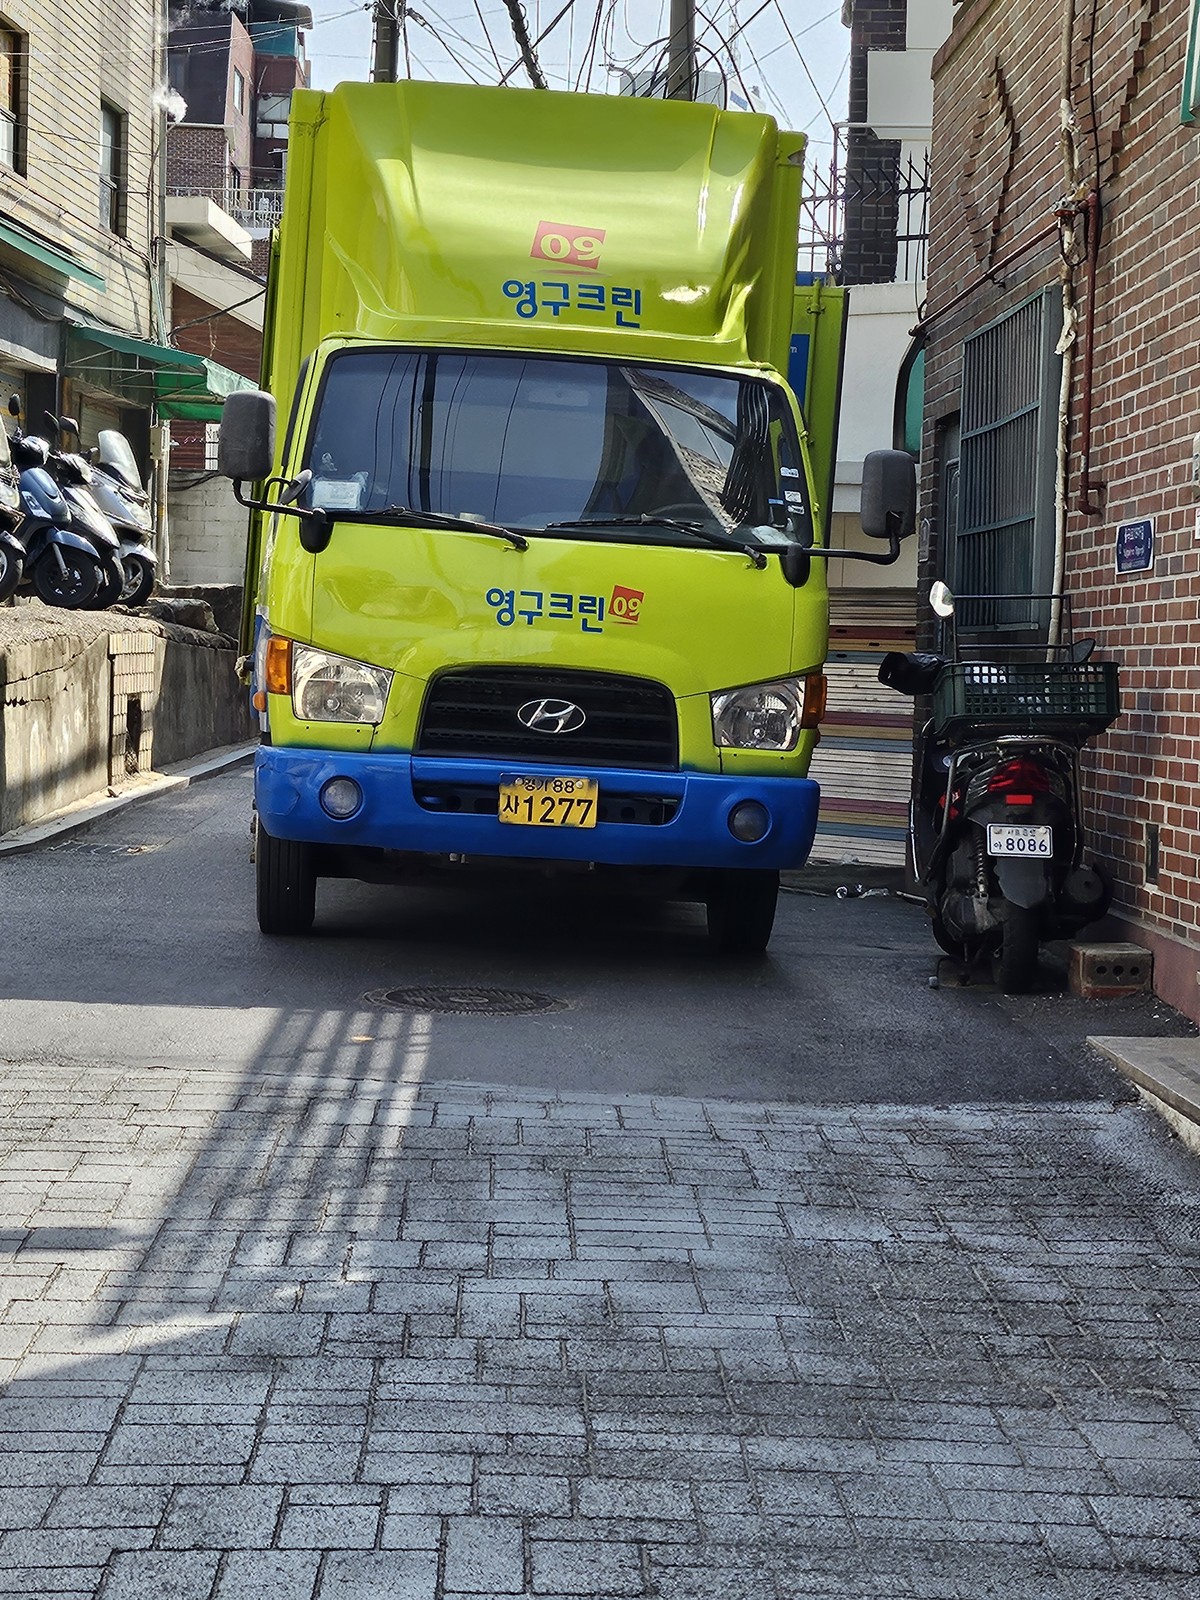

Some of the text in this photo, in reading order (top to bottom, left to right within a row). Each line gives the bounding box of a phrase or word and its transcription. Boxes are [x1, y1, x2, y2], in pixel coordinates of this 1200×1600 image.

[540, 234, 604, 261] 09
[502, 280, 641, 329] 영구크린
[486, 587, 643, 633] 영구크린 09
[552, 779, 575, 793] 88
